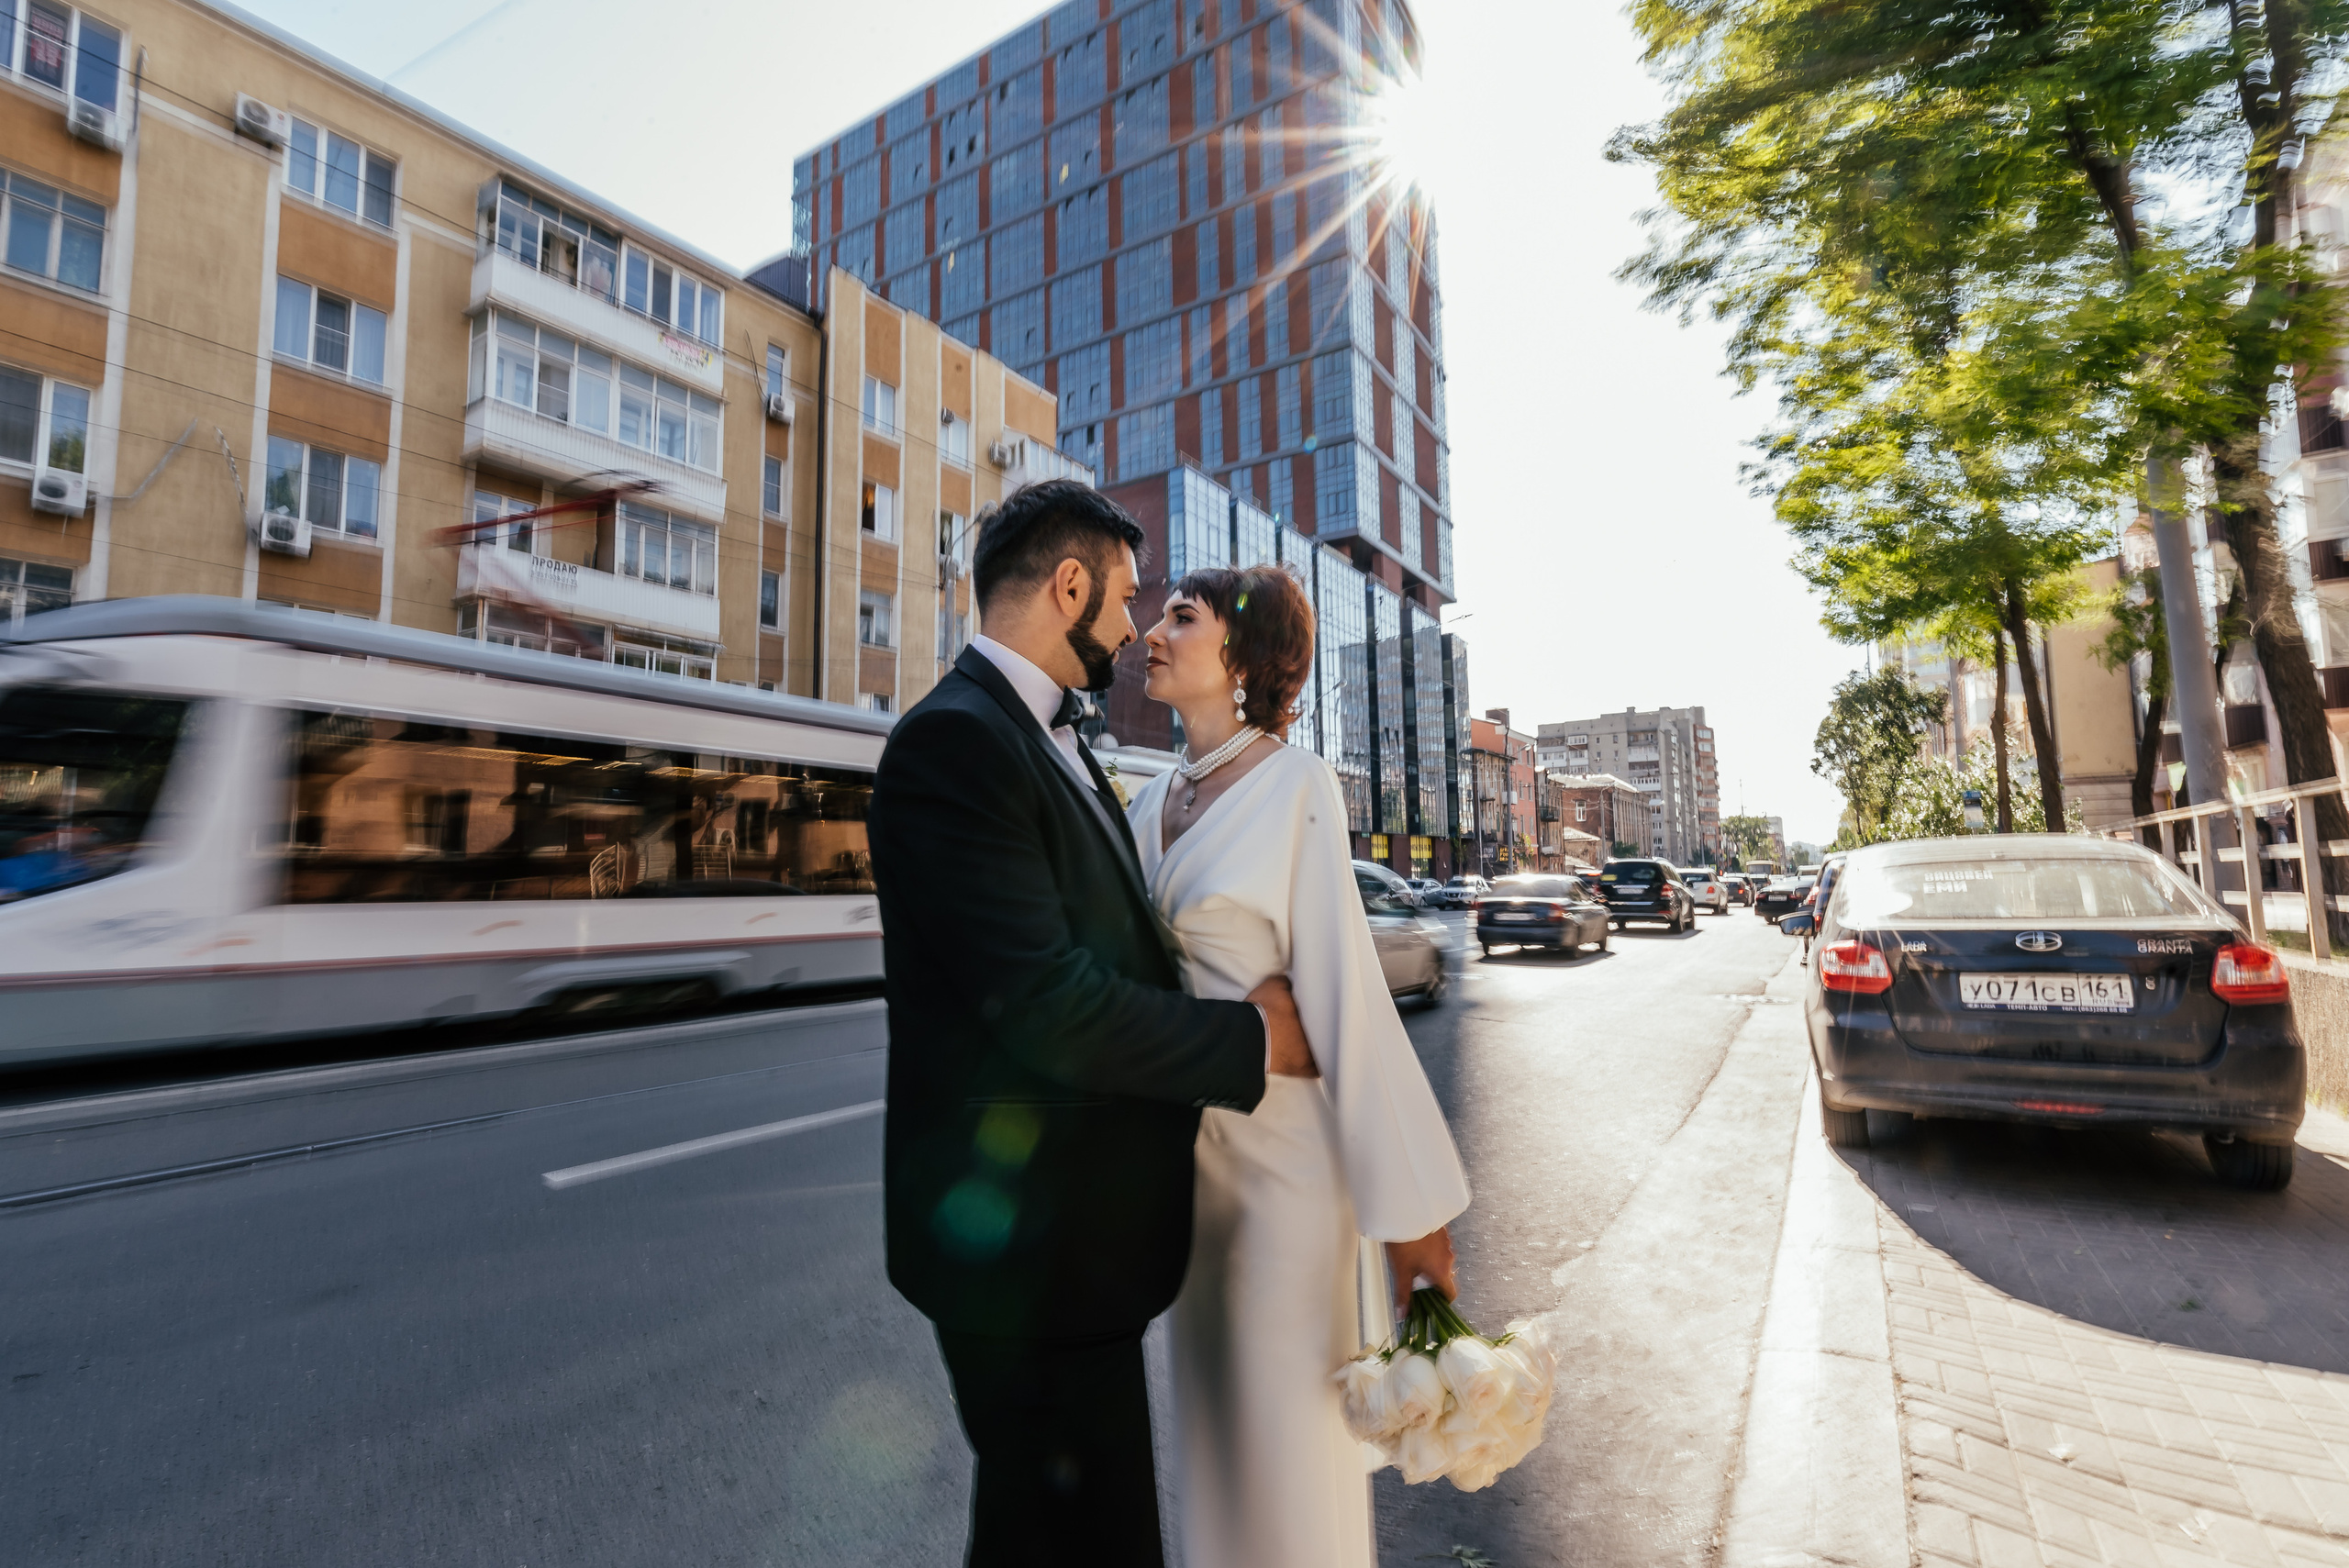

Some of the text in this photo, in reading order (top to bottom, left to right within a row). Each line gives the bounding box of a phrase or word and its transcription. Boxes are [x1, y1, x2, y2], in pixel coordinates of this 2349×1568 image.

[532, 555, 578, 574] ПРОДАЮ
[1901, 940, 1927, 952] LADA
[2137, 939, 2194, 954] GRANTA
[2082, 975, 2124, 999] 161
